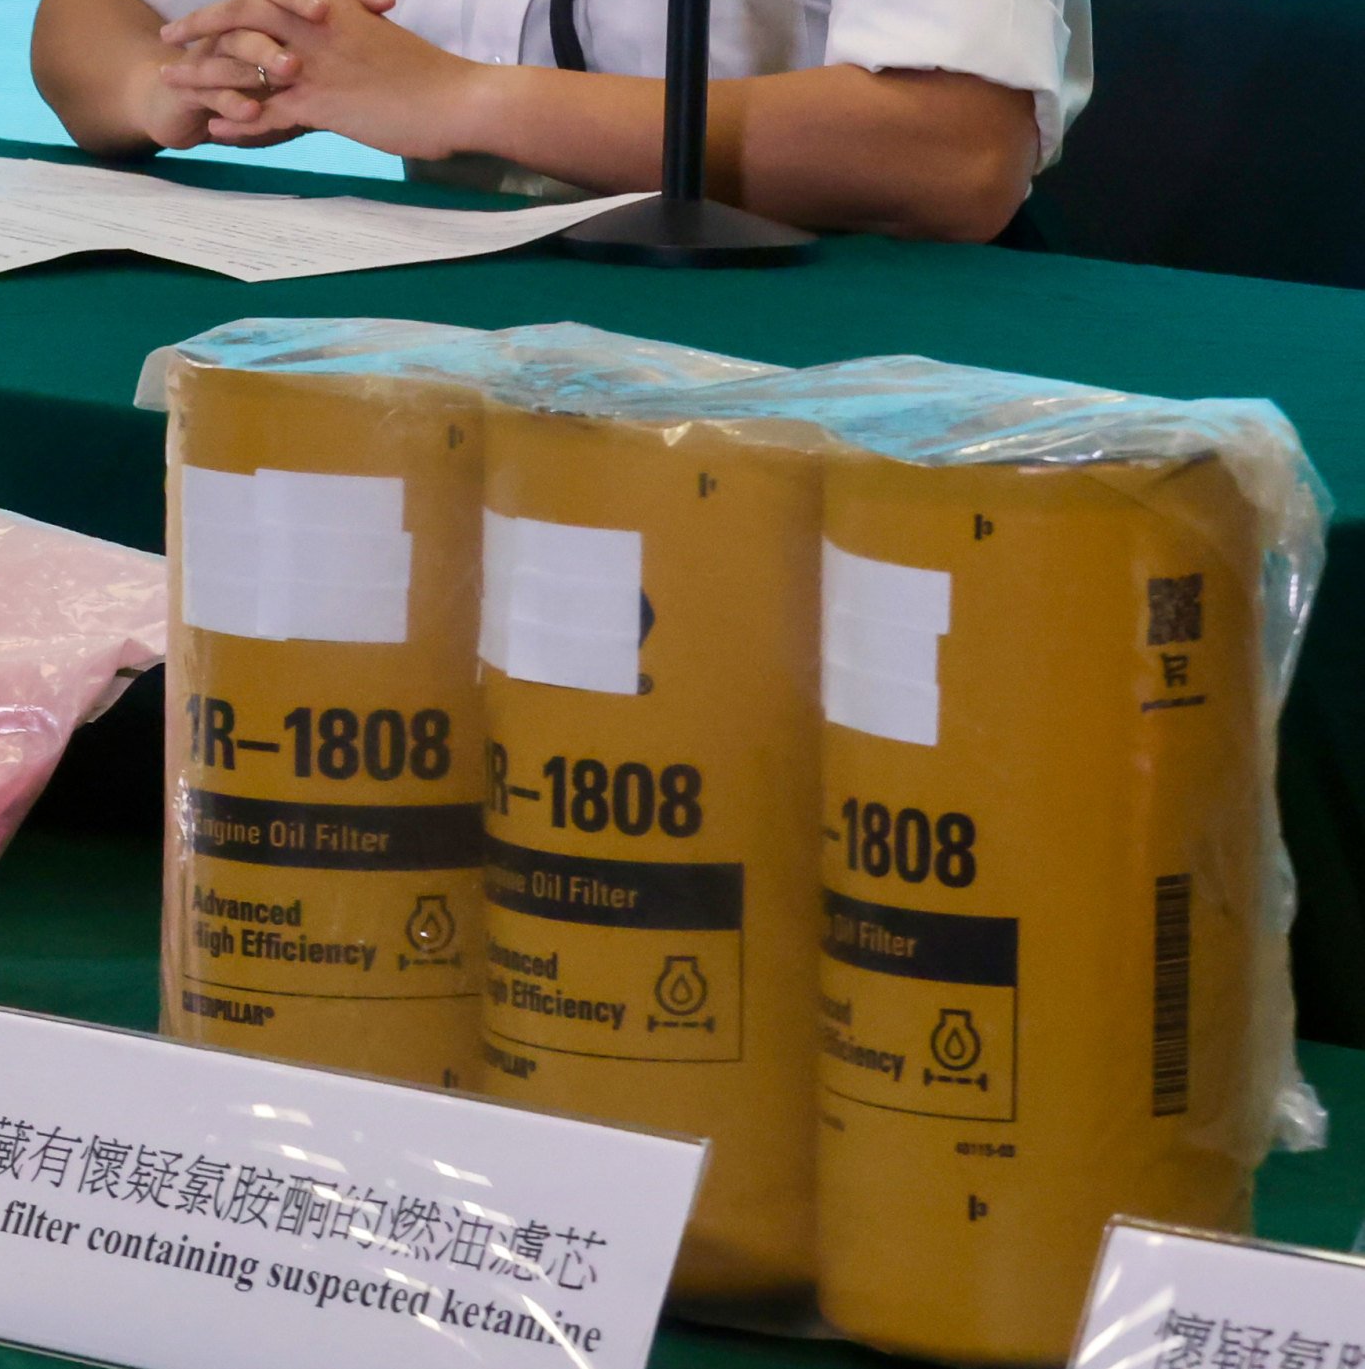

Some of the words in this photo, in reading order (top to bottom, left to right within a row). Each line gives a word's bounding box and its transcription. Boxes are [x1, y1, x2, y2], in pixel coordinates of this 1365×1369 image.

[487, 738, 703, 838] R-1808
[193, 808, 260, 846] Engine
[270, 820, 305, 850] Oil
[315, 824, 390, 852] Filter
[824, 797, 977, 889] -1808
[191, 885, 302, 927] Advanced
[532, 870, 561, 900] Oil
[569, 875, 638, 908] Filter
[240, 930, 378, 972] Efficiency
[858, 920, 918, 958] Filter
[511, 979, 627, 1031] Efficiency
[1, 1197, 81, 1247] filter
[86, 1221, 261, 1294] containing
[267, 1258, 432, 1322] suspected
[440, 1296, 604, 1356] ketamine
